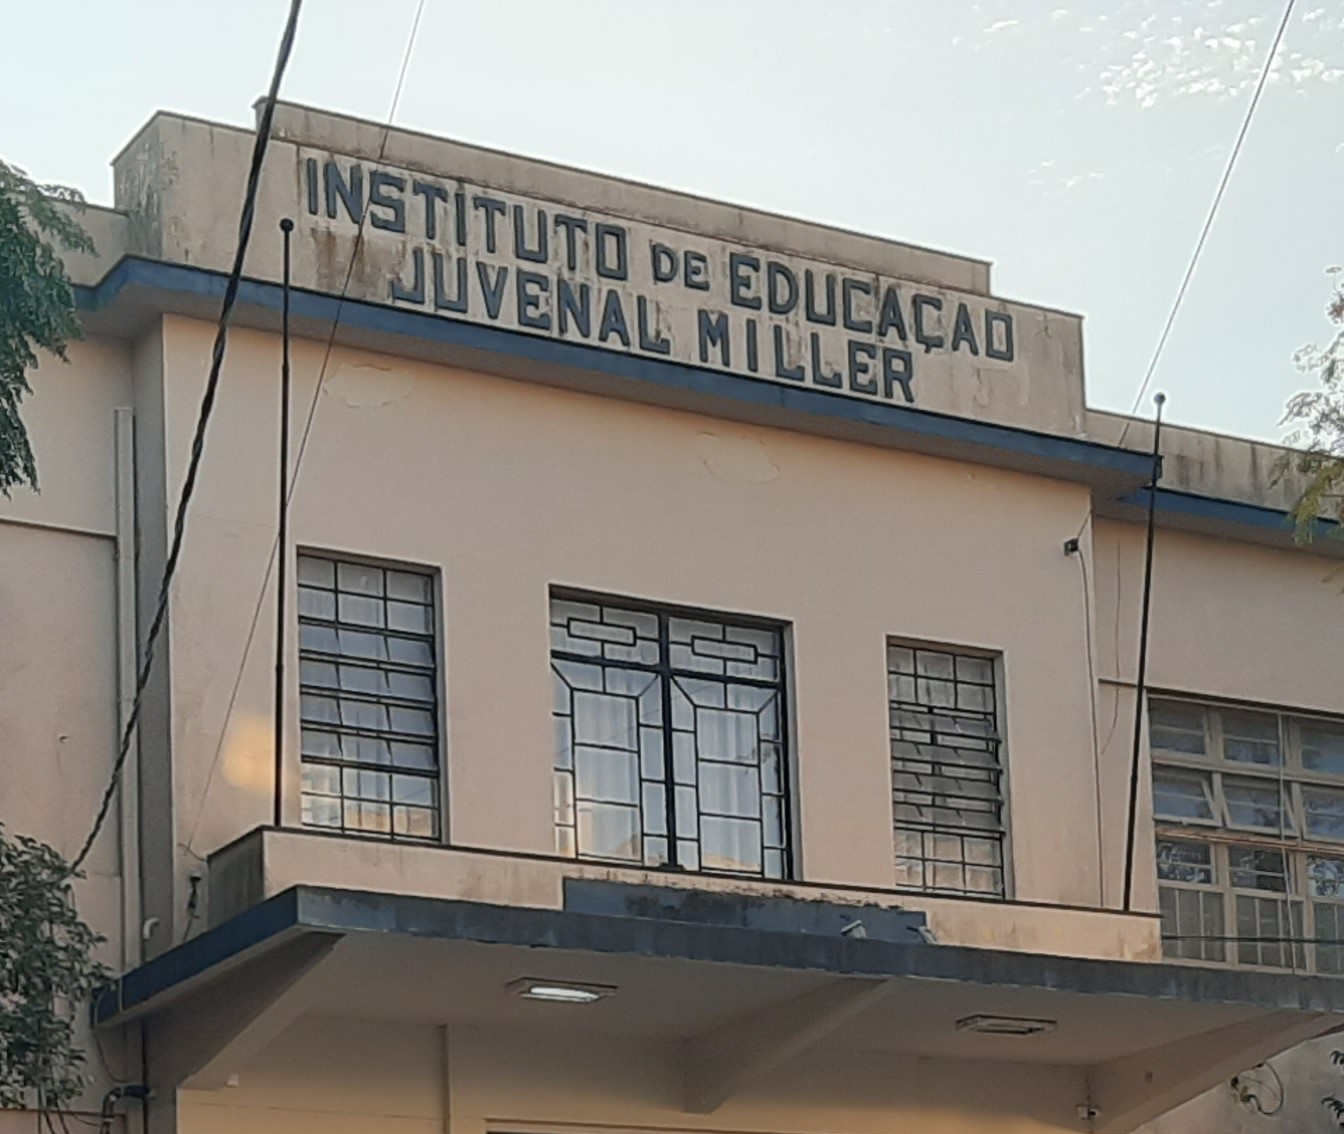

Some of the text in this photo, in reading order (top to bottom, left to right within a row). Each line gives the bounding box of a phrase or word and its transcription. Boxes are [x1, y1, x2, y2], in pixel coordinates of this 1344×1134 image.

[306, 157, 629, 282] INSTITUTO
[650, 242, 710, 292] DE
[390, 246, 915, 403] JUVENAL MILLER
